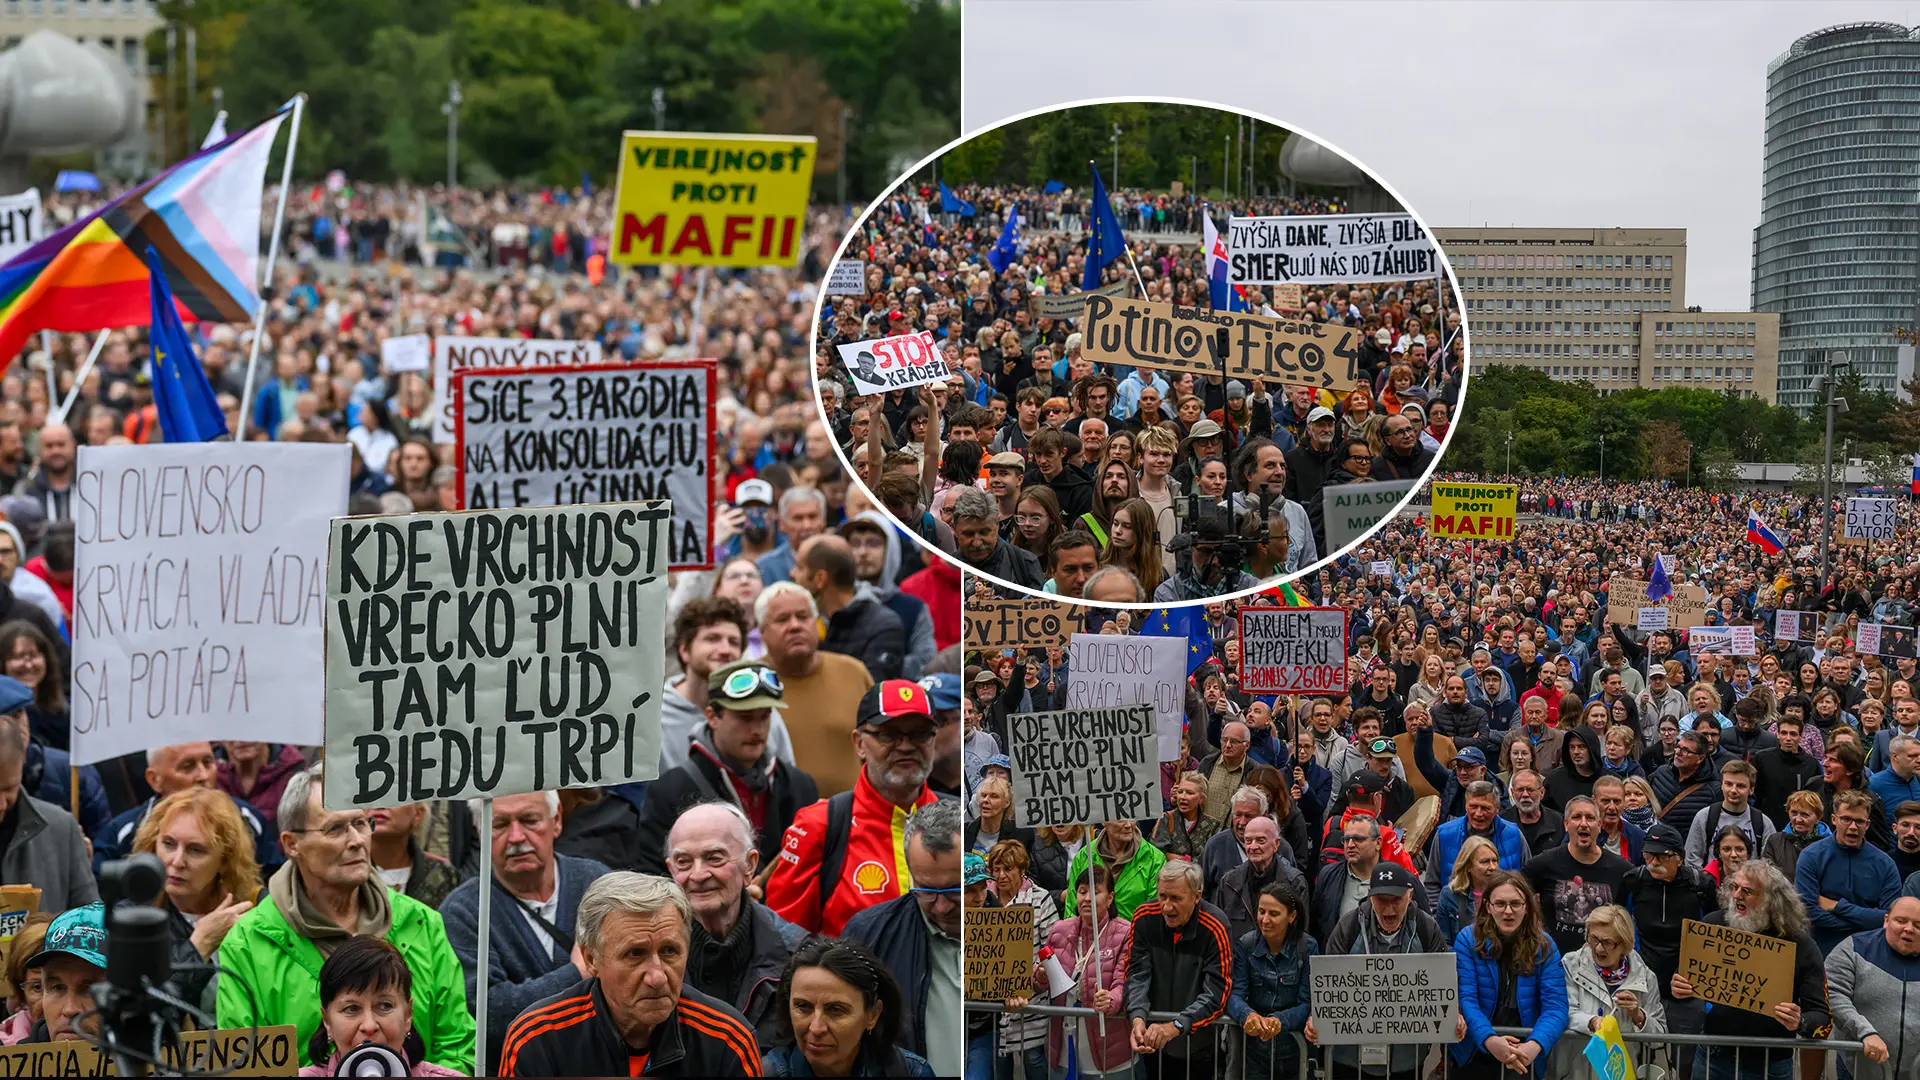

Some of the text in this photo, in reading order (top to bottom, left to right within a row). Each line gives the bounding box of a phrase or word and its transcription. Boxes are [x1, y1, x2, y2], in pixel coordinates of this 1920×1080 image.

[632, 145, 807, 174] VEREJNOSŤ
[671, 181, 757, 204] PROTI
[619, 212, 796, 258] MAFII
[1232, 221, 1281, 249] ZVÝŠIA
[1286, 225, 1332, 248] DANE,
[1338, 218, 1386, 245] ZVÝŠIA
[1320, 251, 1347, 276] NÁS
[1353, 258, 1369, 274] DO
[1373, 244, 1437, 276] ZÁHUBY
[872, 332, 935, 369] STOP
[885, 361, 949, 386] KRÁDEŽI
[465, 445, 497, 473] NA
[78, 465, 265, 544] SLOVENSKO
[1336, 495, 1351, 506] AJ
[1356, 493, 1372, 506] JA
[1436, 487, 1514, 500] VEREJNOSŤ
[1455, 502, 1493, 513] PROTI
[1850, 500, 1895, 513] 1. SK
[1434, 515, 1512, 537] MAFII
[1847, 513, 1894, 526] DICK
[1847, 526, 1893, 538] TATOR
[341, 520, 433, 594] KDE
[443, 501, 669, 588] VRCHNOSŤ
[219, 546, 324, 627] VLÁDA
[338, 576, 658, 667] VRECKO PLNÍ
[1244, 613, 1341, 638] DARUJEM MOJU
[1069, 642, 1153, 675] SLOVENSKO
[1244, 639, 1328, 665] HYPOTÉKU
[73, 637, 249, 734] SA POTÁPA
[1290, 665, 1343, 689] 2600€
[359, 651, 611, 731] TAM ĽUD
[1011, 703, 1154, 744] KDE VRCHNOSŤ
[353, 692, 651, 804] BIEDU TRPÍ
[1013, 740, 1089, 772] VRECKO
[1095, 734, 1152, 766] PLNÍ
[1024, 764, 1135, 797] TAM ĽUD
[1025, 782, 1155, 825] BIEDU TRPÍ
[964, 911, 1031, 925] SLOVENSKO
[970, 928, 993, 942] SAS
[996, 928, 1003, 942] A
[1007, 927, 1032, 941] KDH.
[1687, 922, 1786, 954] KOLABORANT
[1703, 940, 1750, 960] FICO
[991, 961, 1005, 975] AJ
[1011, 960, 1027, 975] PS
[1366, 958, 1394, 971] FICO
[1688, 958, 1768, 988] PUTINOV
[993, 976, 1032, 991] ŠIMEČKA
[1315, 969, 1429, 988] STRAŠNE SA BOJÍŠ
[1687, 971, 1761, 997] TRÓJSKÝ
[981, 990, 1018, 999] NEBUDE.
[1314, 990, 1349, 1003] TOHO
[1353, 987, 1371, 1003] ČO
[1408, 989, 1416, 1001] A
[1417, 988, 1455, 1001] PRETO
[1315, 1003, 1368, 1019] VRIESKAŠ
[1371, 1006, 1395, 1018] AKO
[1400, 1001, 1437, 1018] PAVIÁN
[1332, 1018, 1363, 1034] TAKÁ
[1367, 1021, 1383, 1034] JE
[1386, 1020, 1429, 1034] PRAVDA
